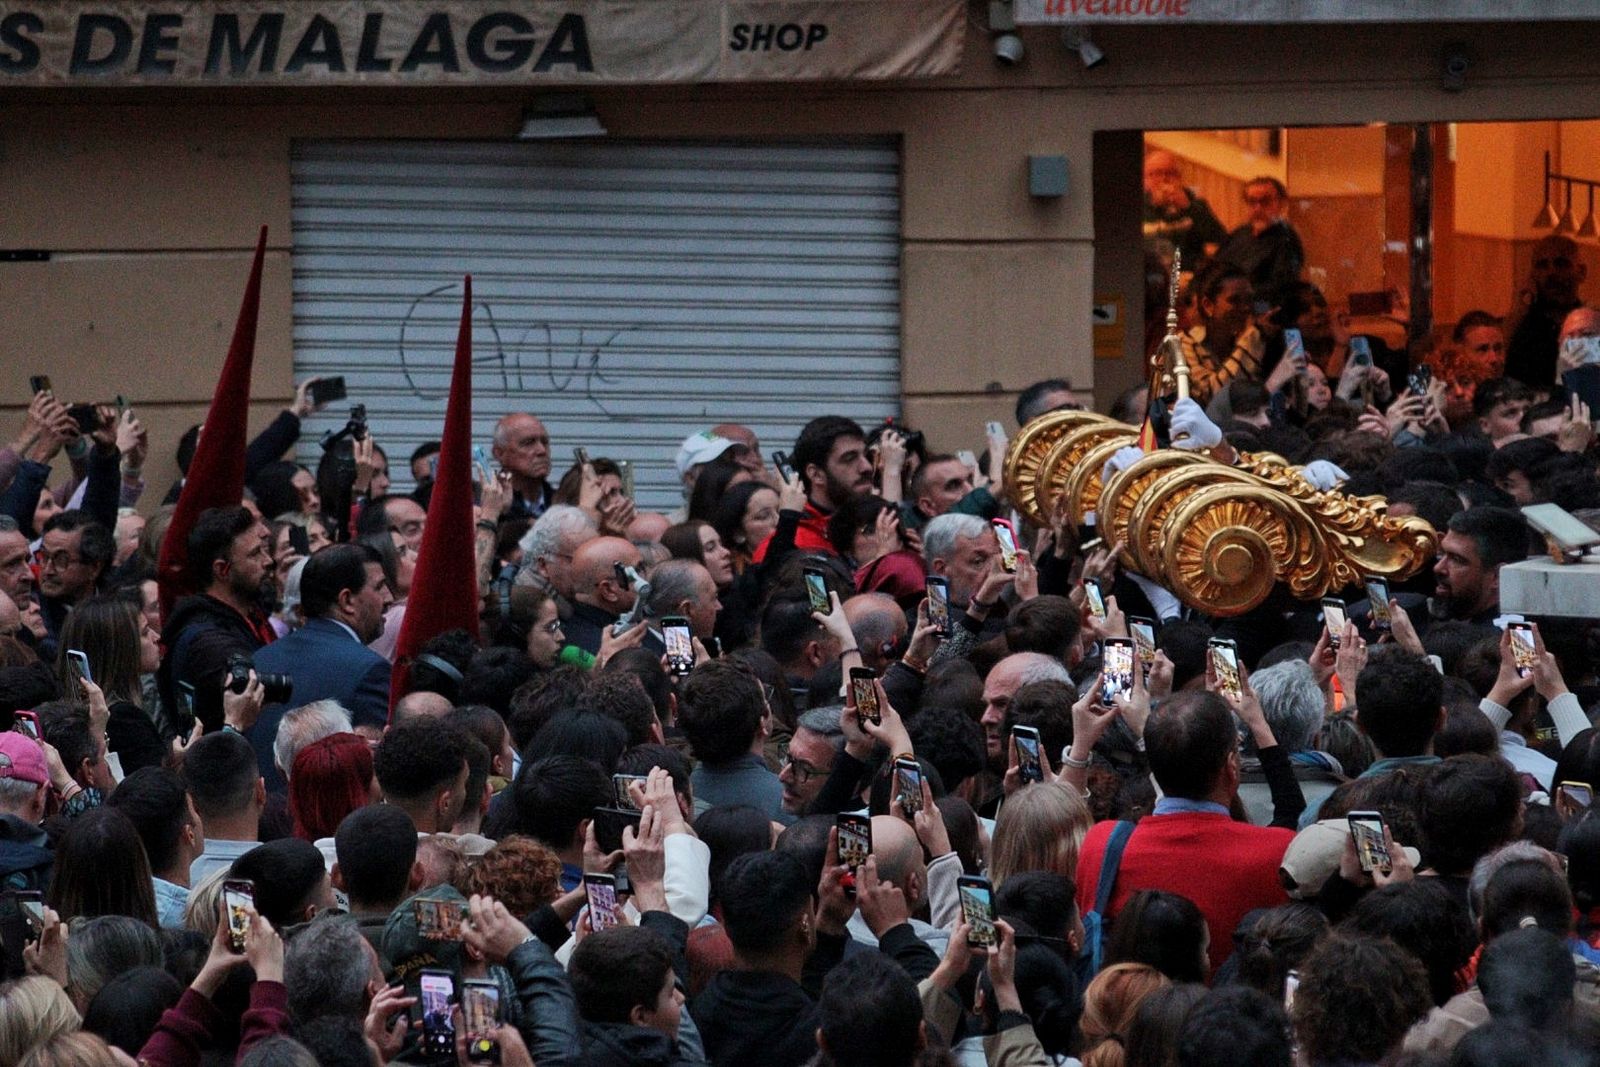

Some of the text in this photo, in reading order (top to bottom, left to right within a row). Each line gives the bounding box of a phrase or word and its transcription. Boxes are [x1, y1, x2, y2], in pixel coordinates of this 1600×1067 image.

[69, 13, 185, 76] DE
[203, 12, 595, 74] MALAGA
[730, 23, 829, 52] SHOP
